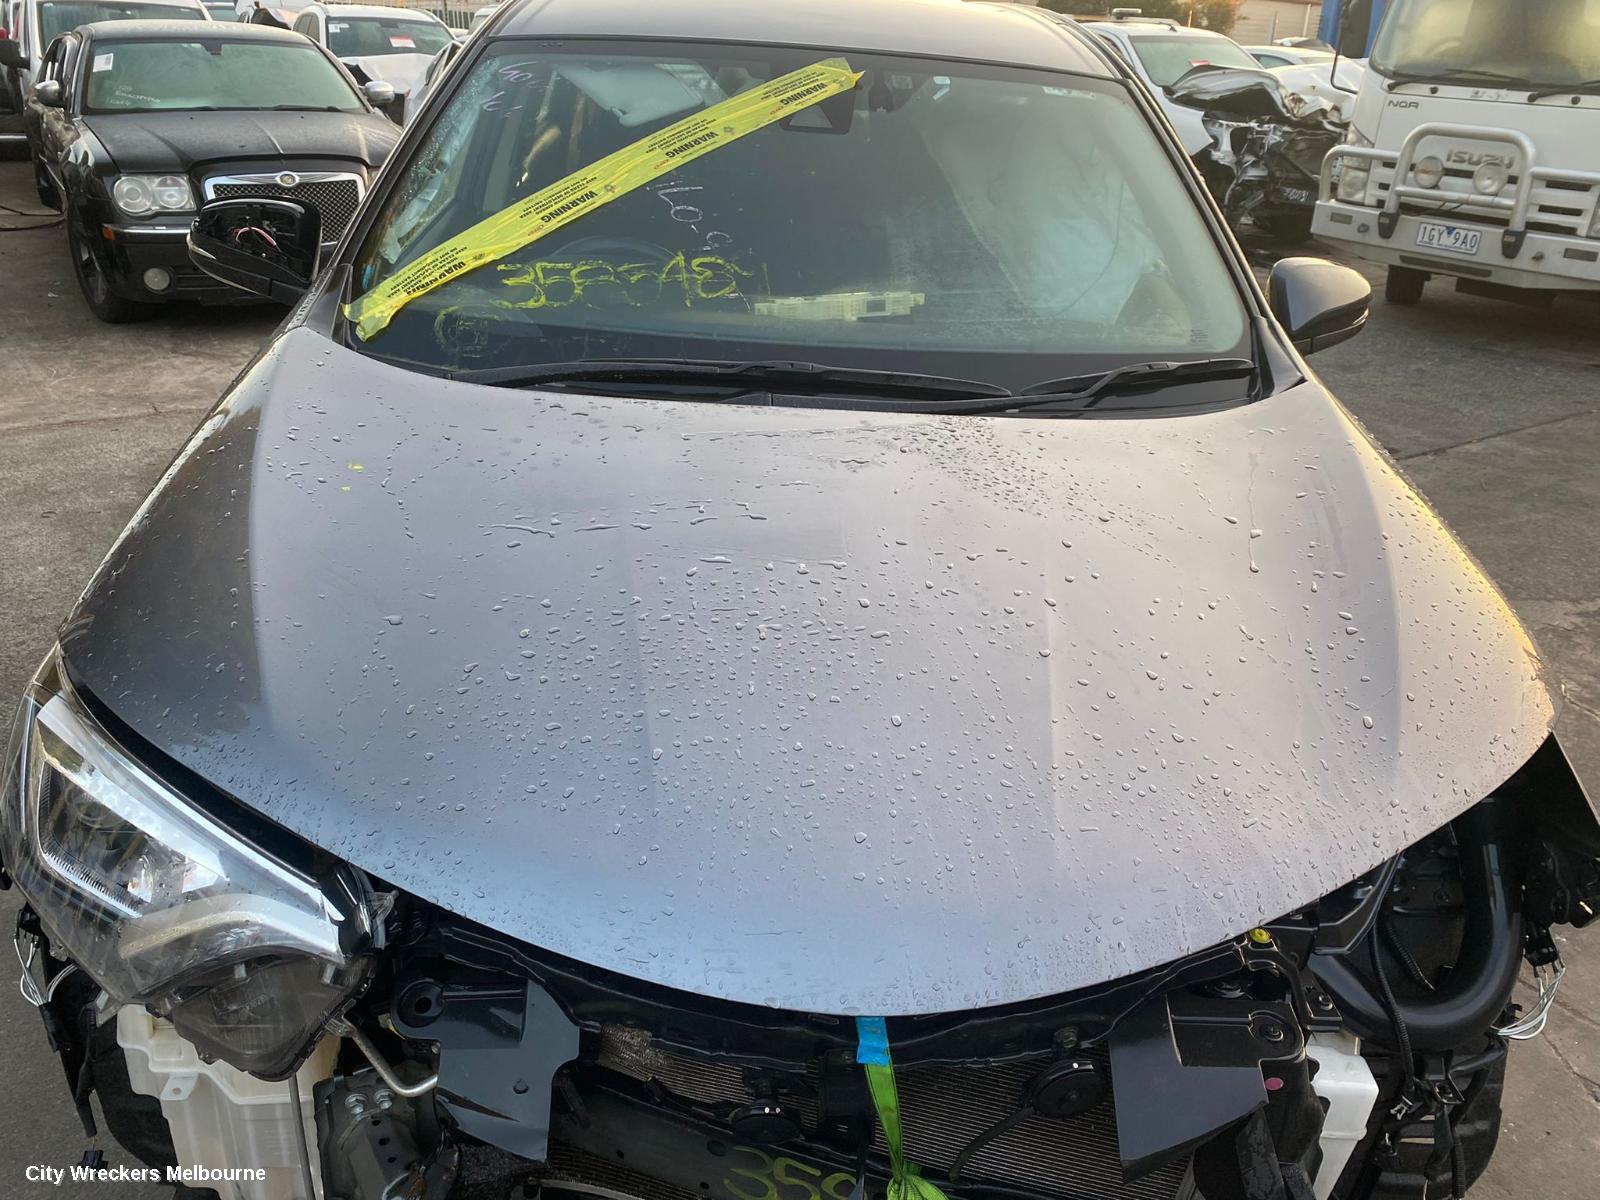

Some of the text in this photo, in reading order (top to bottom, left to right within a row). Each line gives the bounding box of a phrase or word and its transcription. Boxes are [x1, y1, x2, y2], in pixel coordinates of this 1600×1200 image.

[780, 82, 828, 106] WARNING
[665, 131, 718, 158] WARNING
[1446, 149, 1515, 170] ISUZU
[540, 190, 598, 223] WARNING
